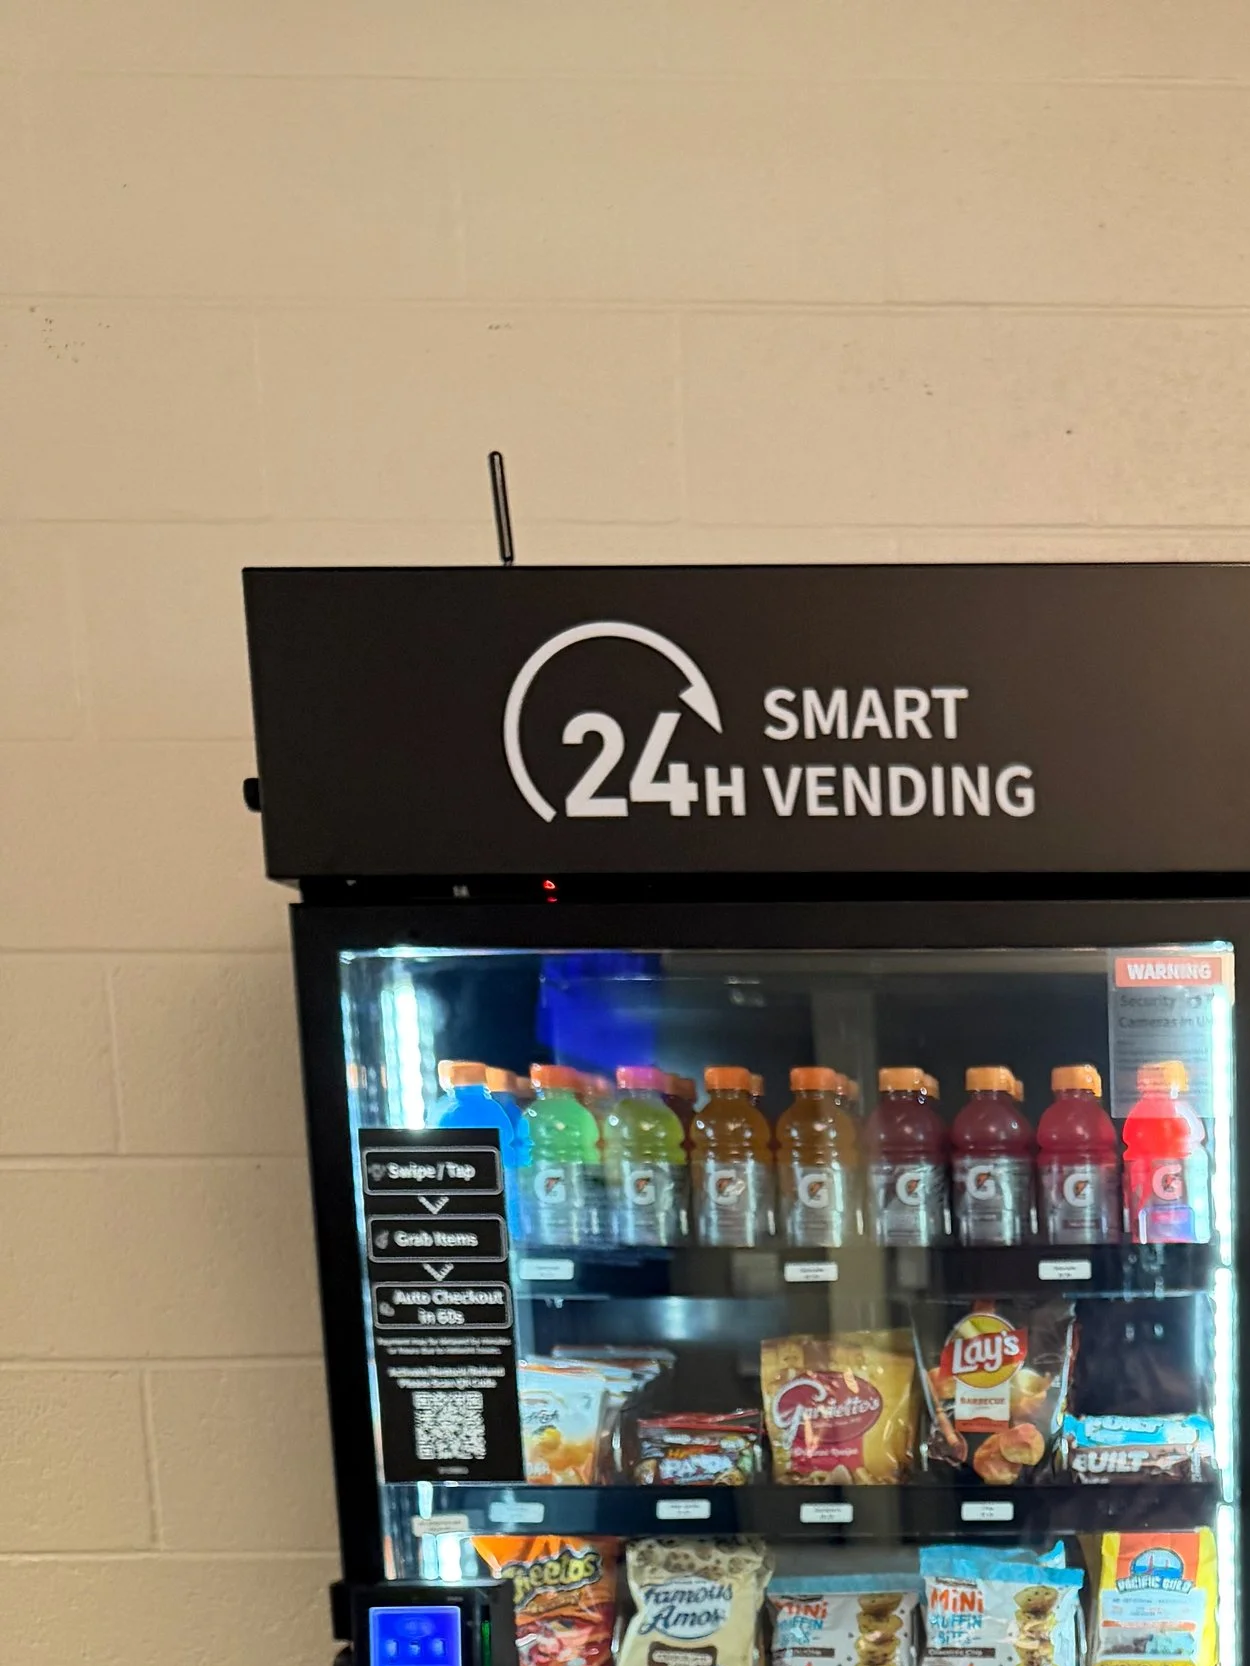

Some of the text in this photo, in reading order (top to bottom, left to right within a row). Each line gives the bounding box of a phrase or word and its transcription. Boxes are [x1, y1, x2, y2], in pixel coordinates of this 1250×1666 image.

[763, 687, 969, 741] SMART
[763, 764, 1036, 818] VENDING
[1127, 964, 1213, 981] WARNING
[1119, 994, 1176, 1009] Security
[1118, 1016, 1177, 1029] Cameras
[386, 1161, 436, 1181] Swipe
[446, 1162, 476, 1181] Tap
[965, 1165, 996, 1201] G
[1151, 1164, 1183, 1201] G
[1063, 1172, 1094, 1208] G
[394, 1230, 479, 1248] Grab Items
[392, 1290, 505, 1306] Auto Checkout
[418, 1308, 433, 1325] in
[952, 1331, 1020, 1374] Lay's
[1072, 1450, 1150, 1474] BUILT
[643, 1583, 733, 1608] Famous
[638, 1605, 726, 1636] Amos
